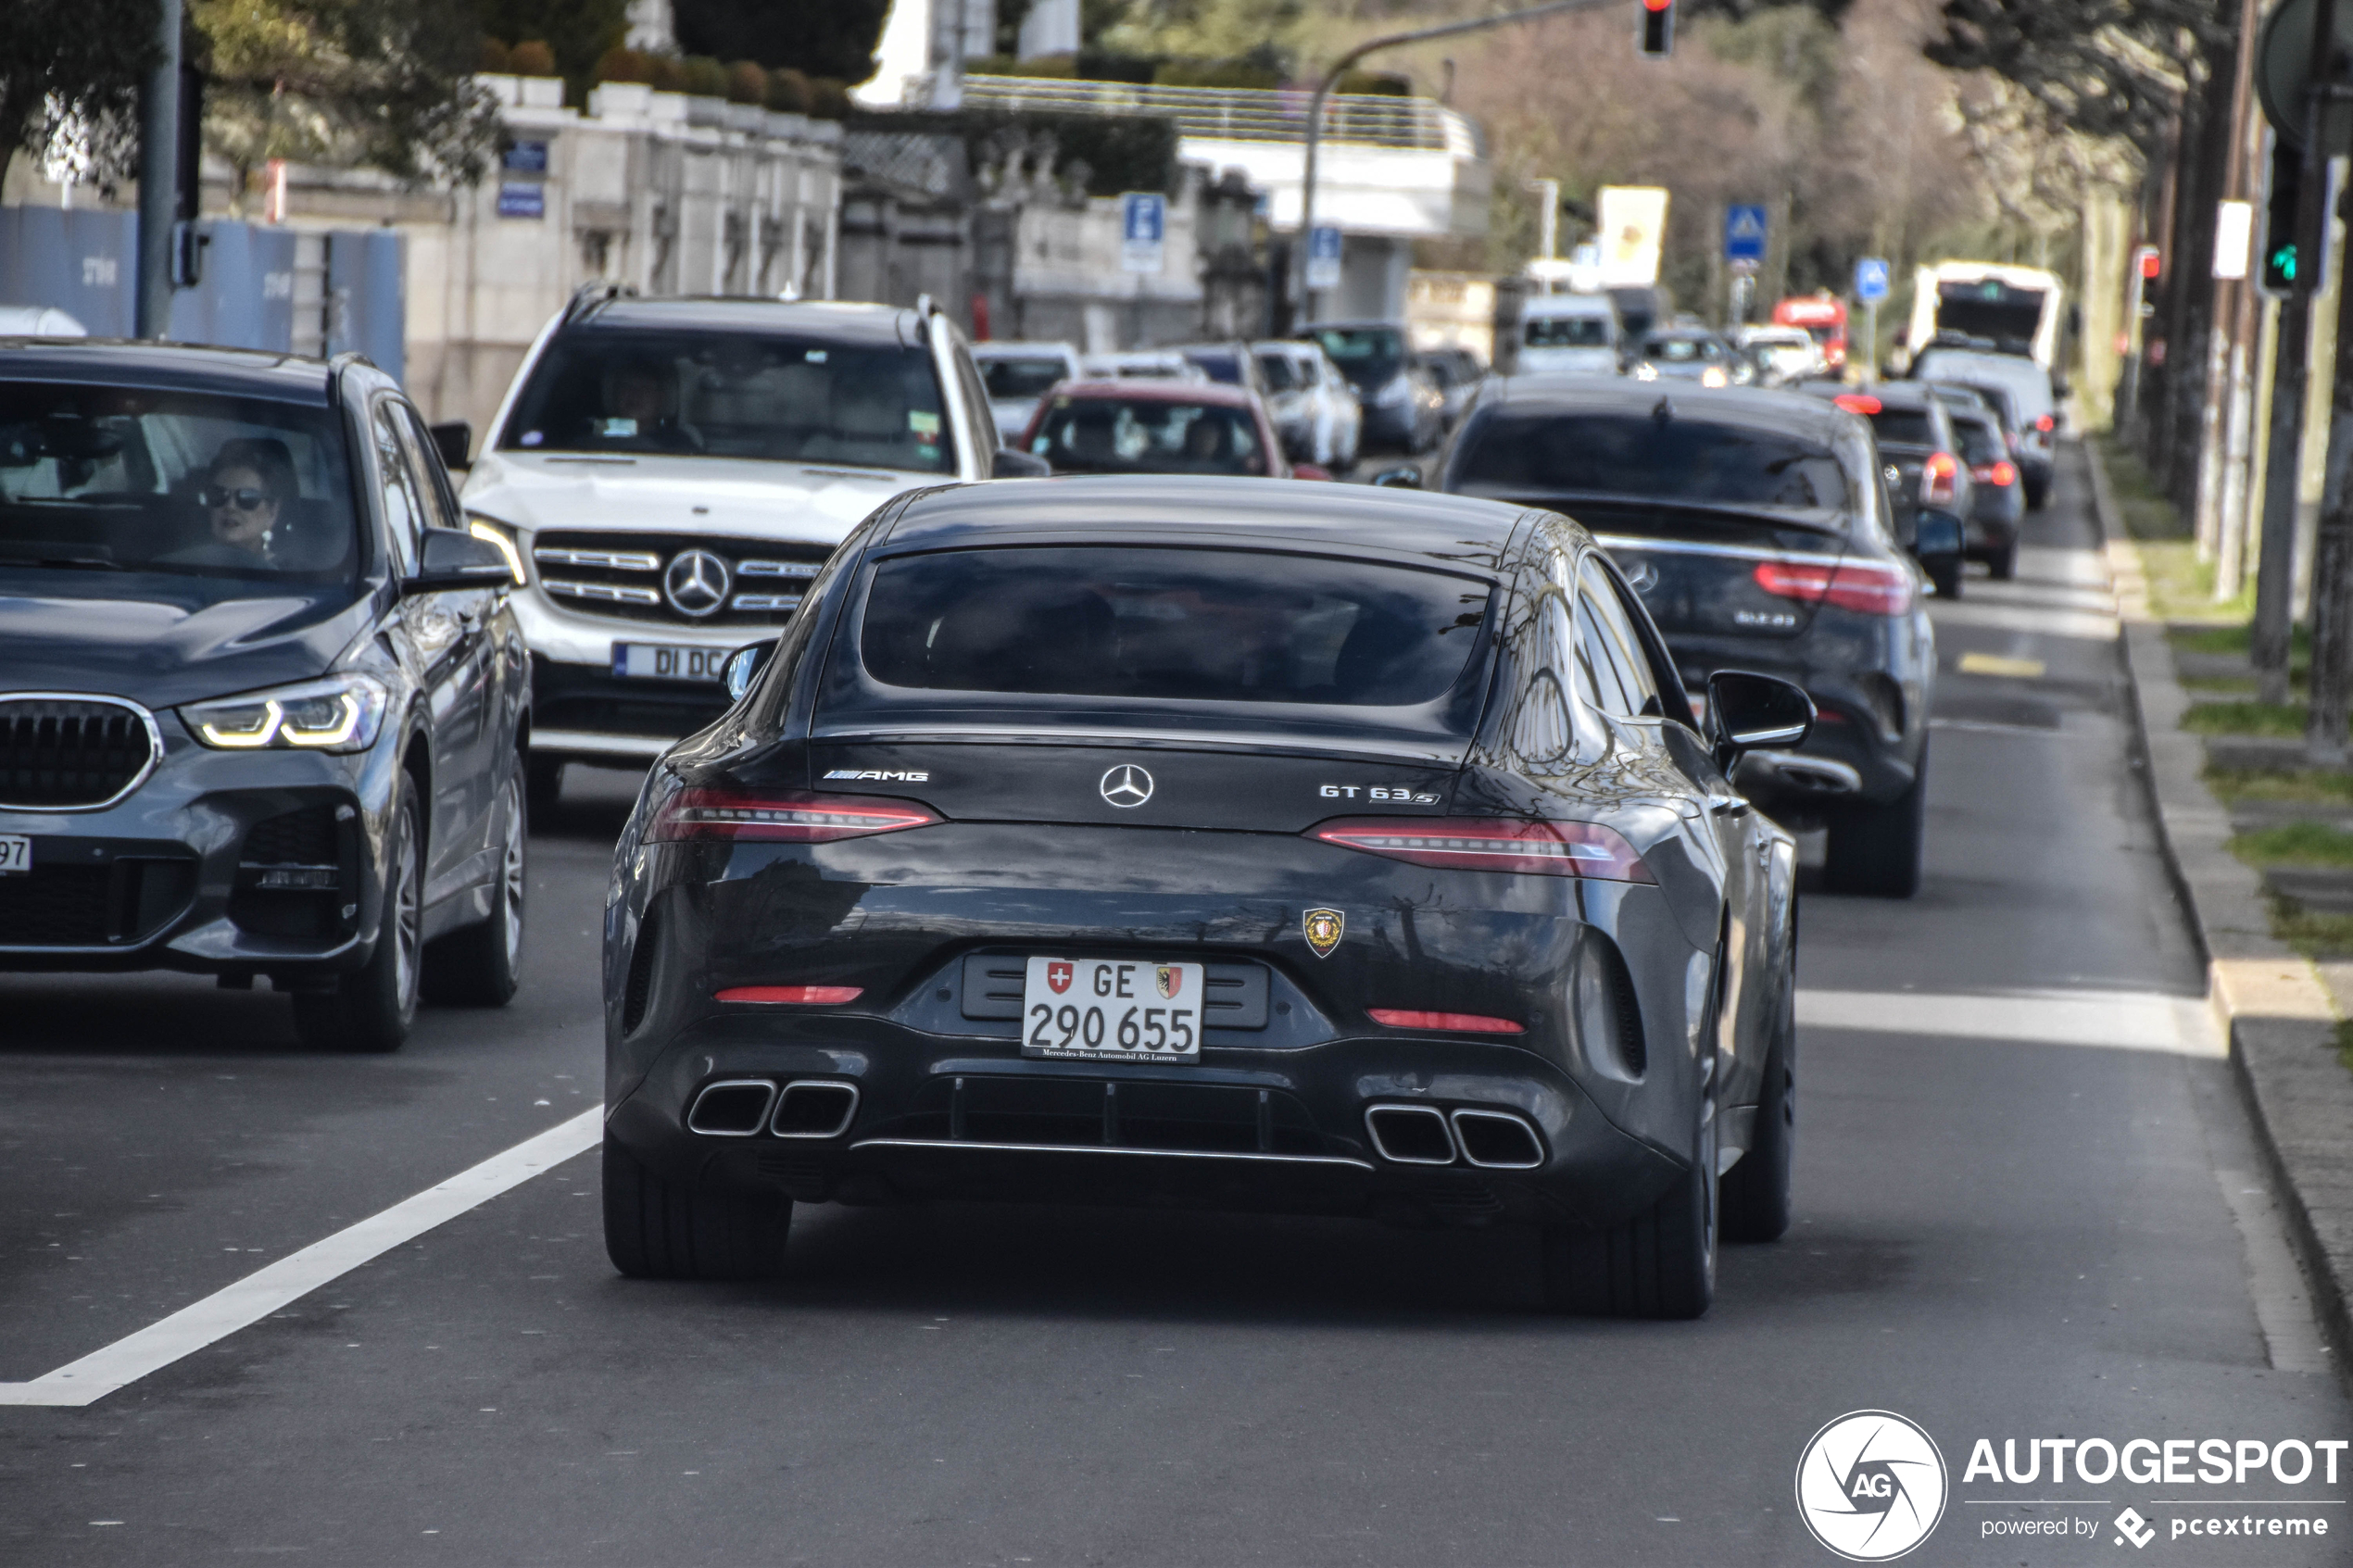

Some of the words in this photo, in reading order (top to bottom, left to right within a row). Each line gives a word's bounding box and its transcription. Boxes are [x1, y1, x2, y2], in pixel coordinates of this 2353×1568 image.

[856, 771, 929, 783] AMG
[1320, 784, 1362, 798] GT
[0, 840, 26, 866] 97
[1093, 964, 1137, 998] GE
[1029, 1003, 1105, 1048] 290
[1117, 1006, 1193, 1053] 655
[1042, 1048, 1097, 1059] Mercedes-Benz
[1098, 1051, 1137, 1060] Automobil
[1137, 1053, 1150, 1061] AG
[1151, 1054, 1177, 1062] Luzern
